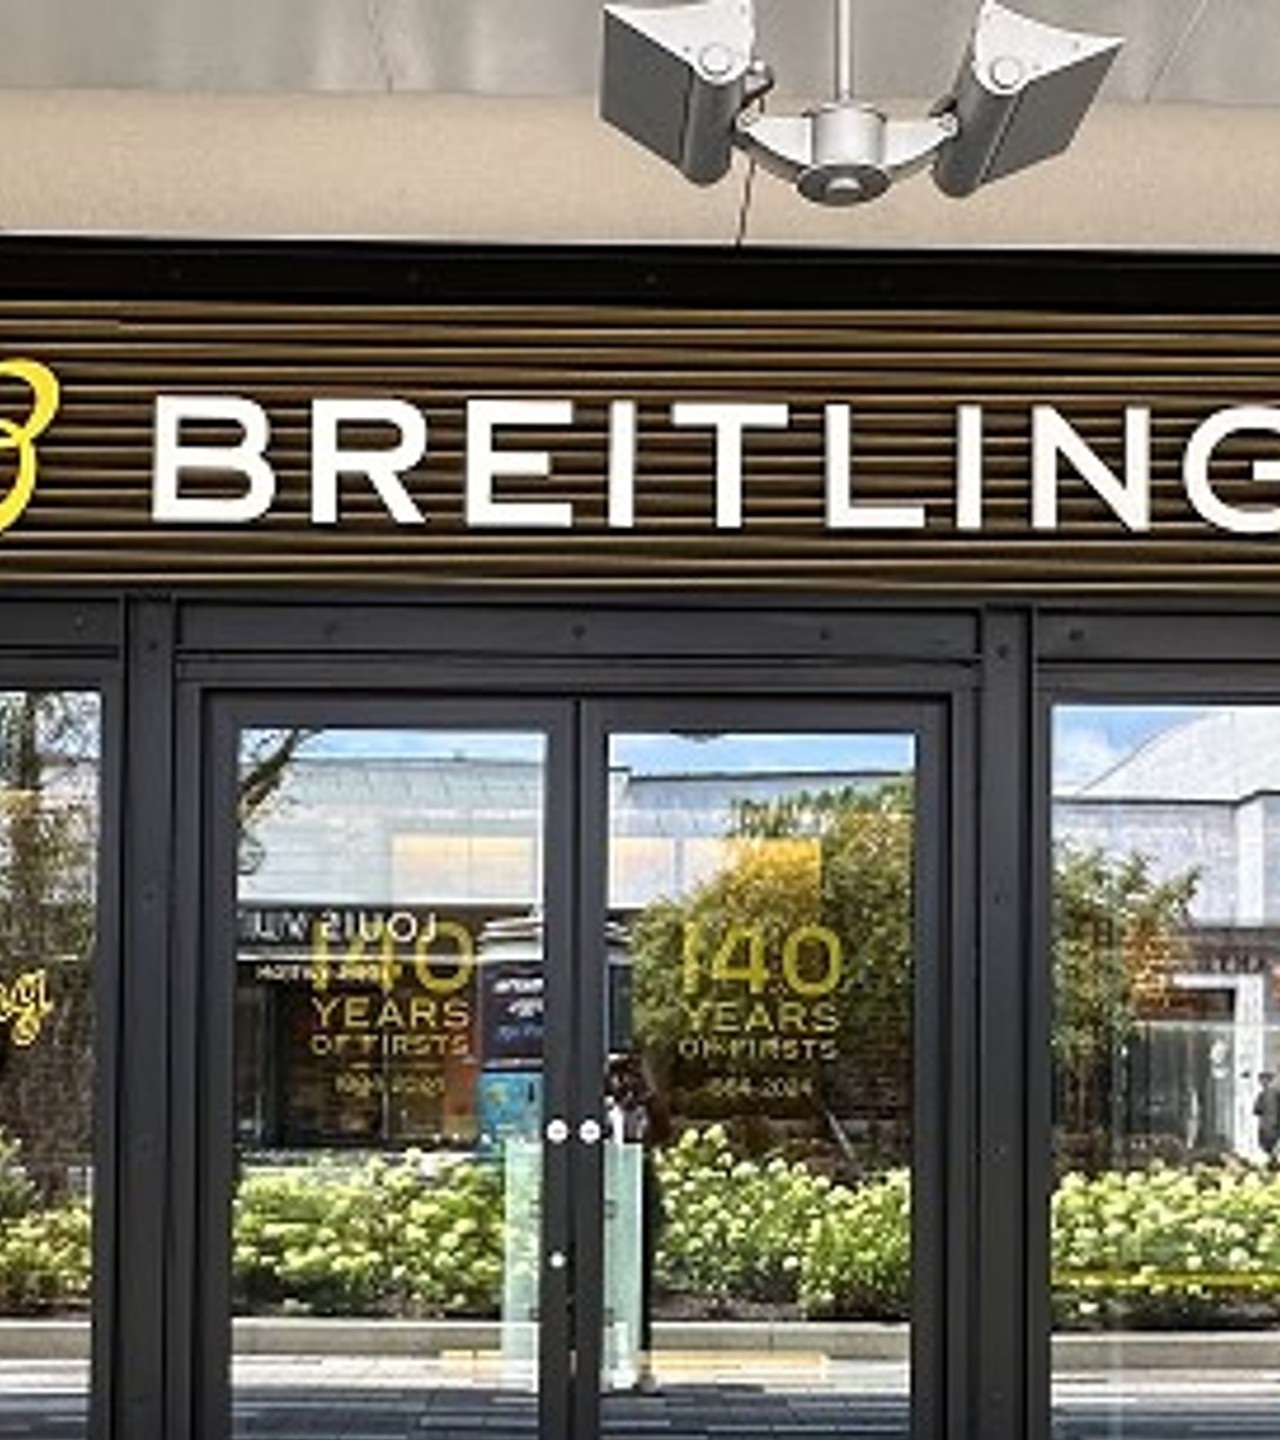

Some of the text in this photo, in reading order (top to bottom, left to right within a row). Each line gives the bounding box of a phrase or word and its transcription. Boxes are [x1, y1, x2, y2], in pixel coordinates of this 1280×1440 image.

[683, 921, 842, 995] 140
[310, 996, 470, 1029] YEARS
[677, 1001, 840, 1032] YEARS
